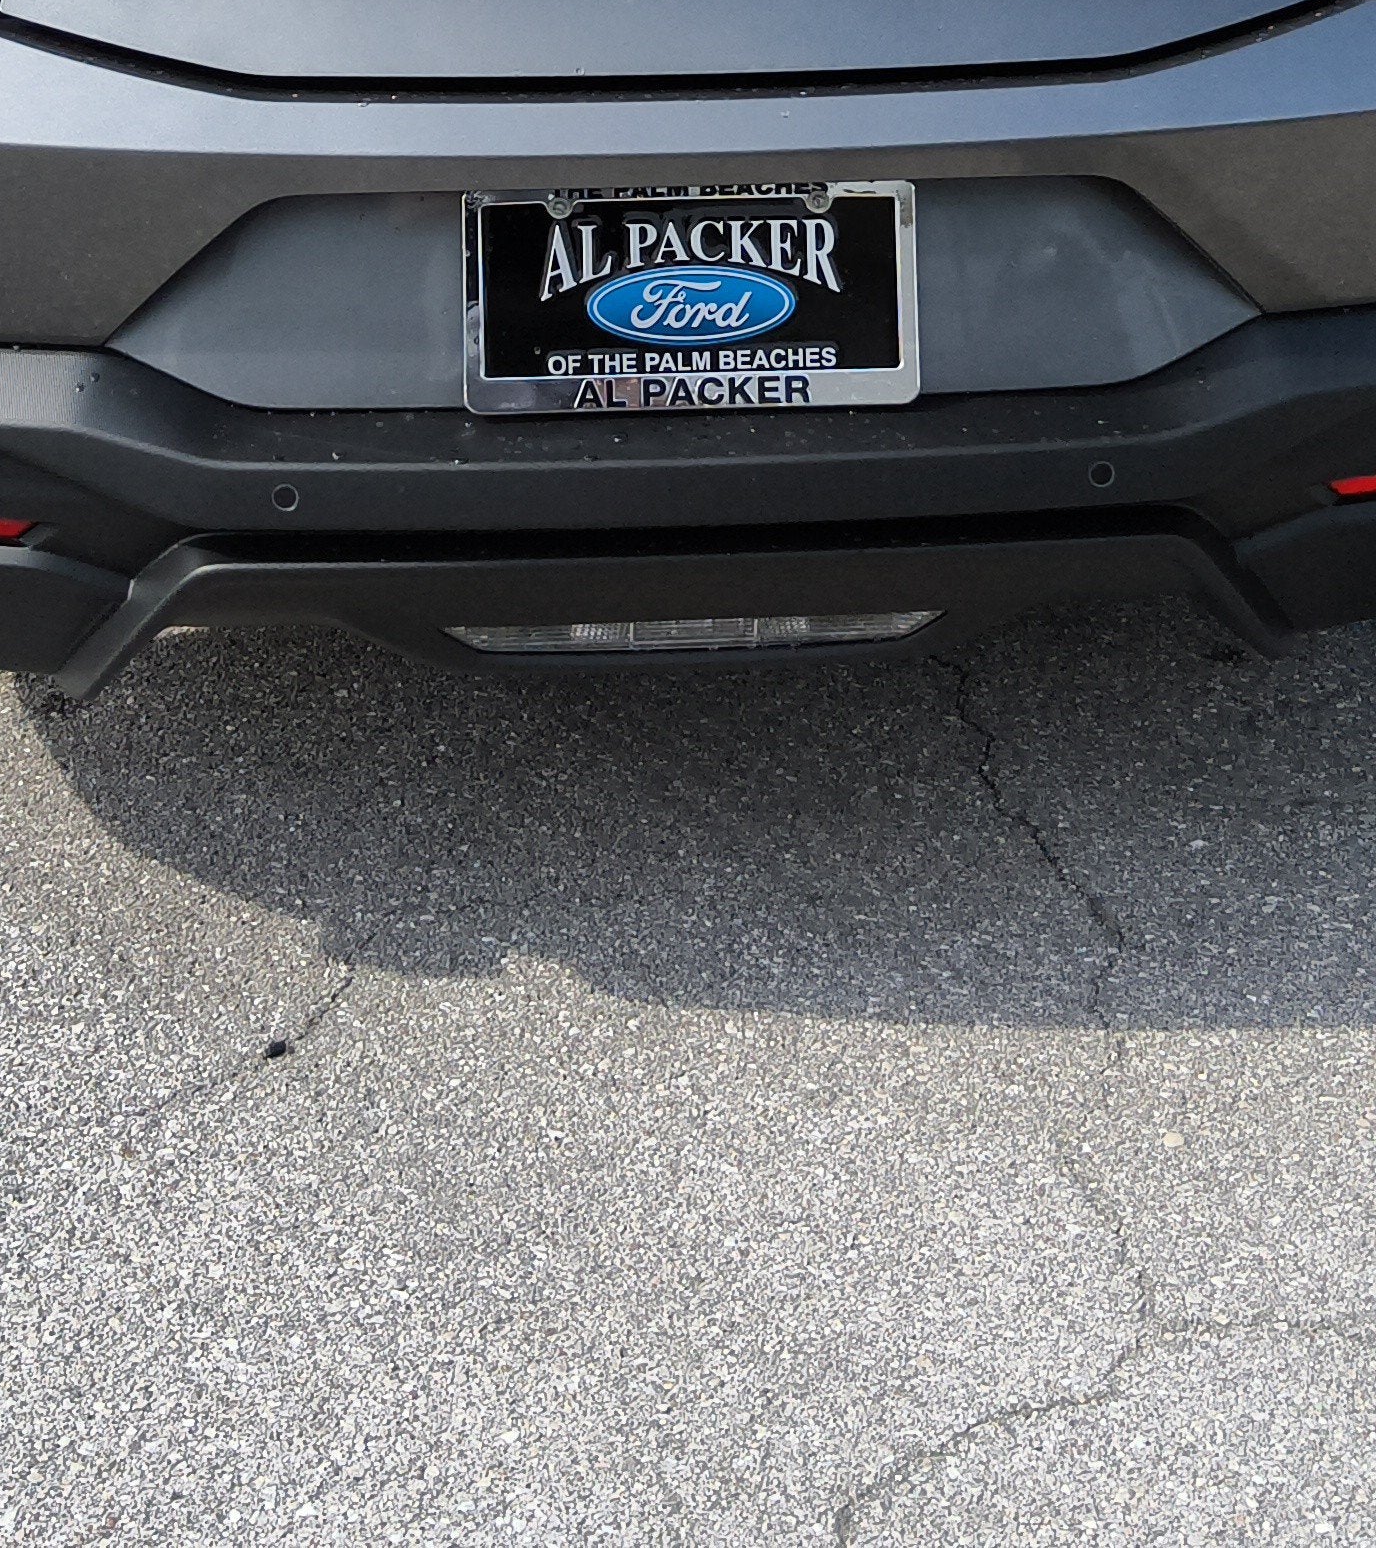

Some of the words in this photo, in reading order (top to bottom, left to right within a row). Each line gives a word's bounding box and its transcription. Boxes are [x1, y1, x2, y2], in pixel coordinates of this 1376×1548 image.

[540, 223, 613, 302] AL
[625, 218, 841, 293] PACKER
[630, 279, 753, 329] Ford
[547, 354, 582, 375] OF
[587, 353, 638, 373] THE
[644, 351, 712, 372] PALM
[718, 347, 838, 370] BEACHES
[575, 378, 627, 408] AL
[641, 373, 812, 407] PACKER
